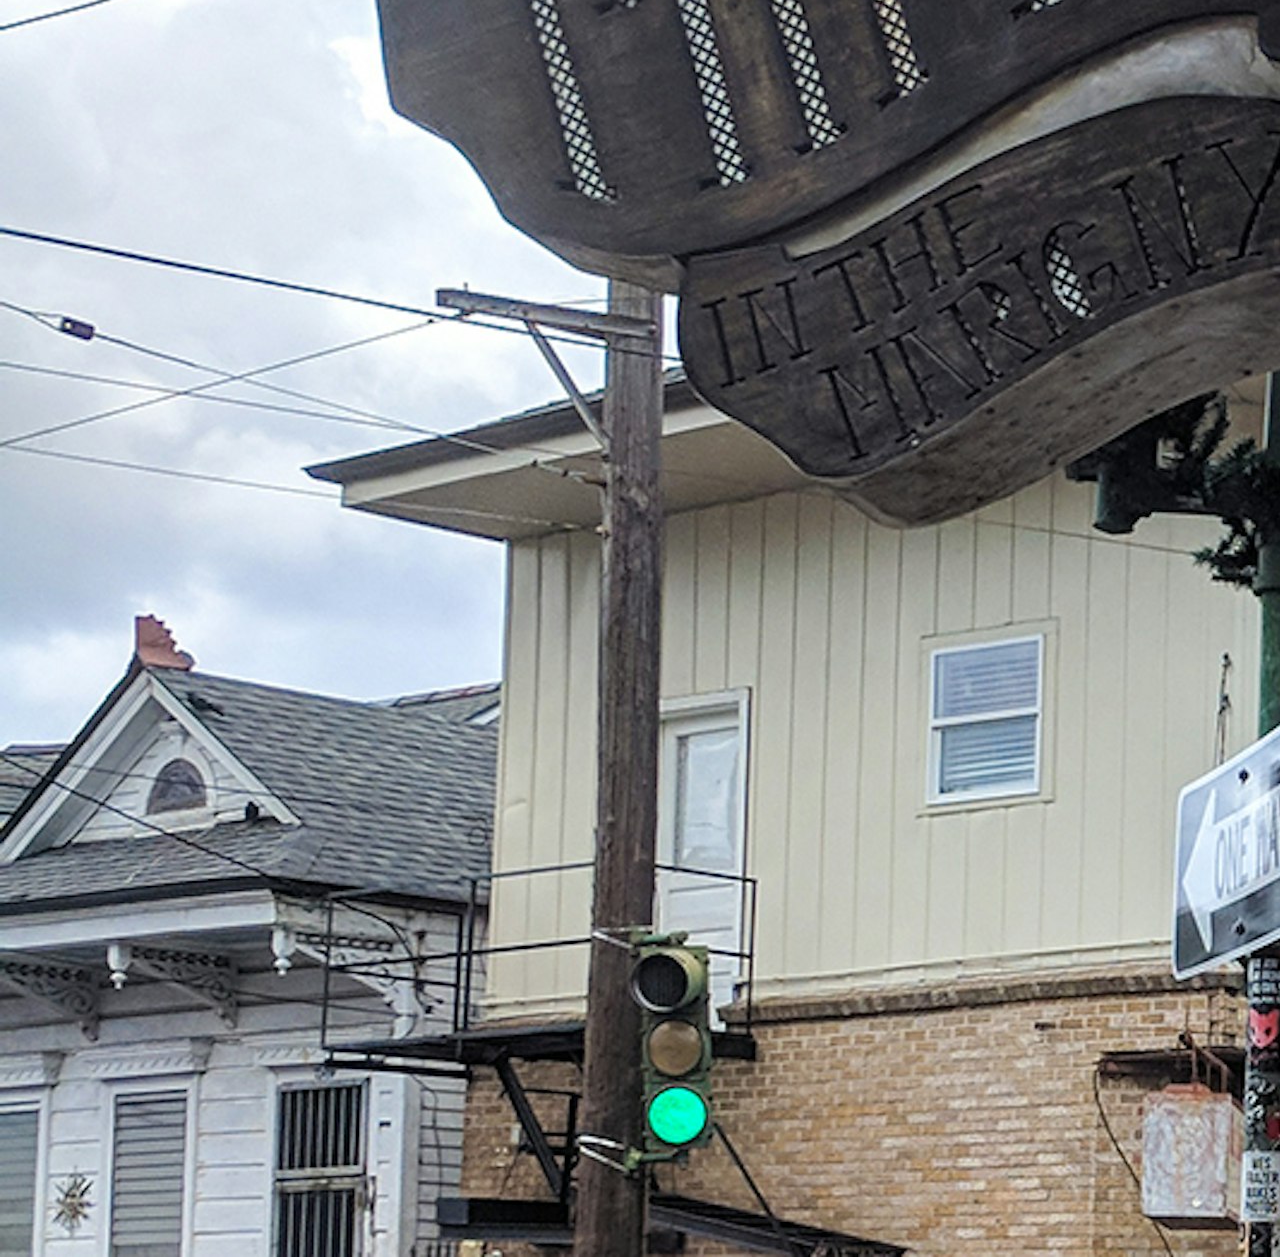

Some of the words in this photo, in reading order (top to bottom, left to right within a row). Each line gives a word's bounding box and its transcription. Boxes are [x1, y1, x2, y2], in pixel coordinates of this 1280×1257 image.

[702, 277, 811, 388] IN
[812, 183, 1004, 333] THE
[1214, 815, 1250, 900] ONE
